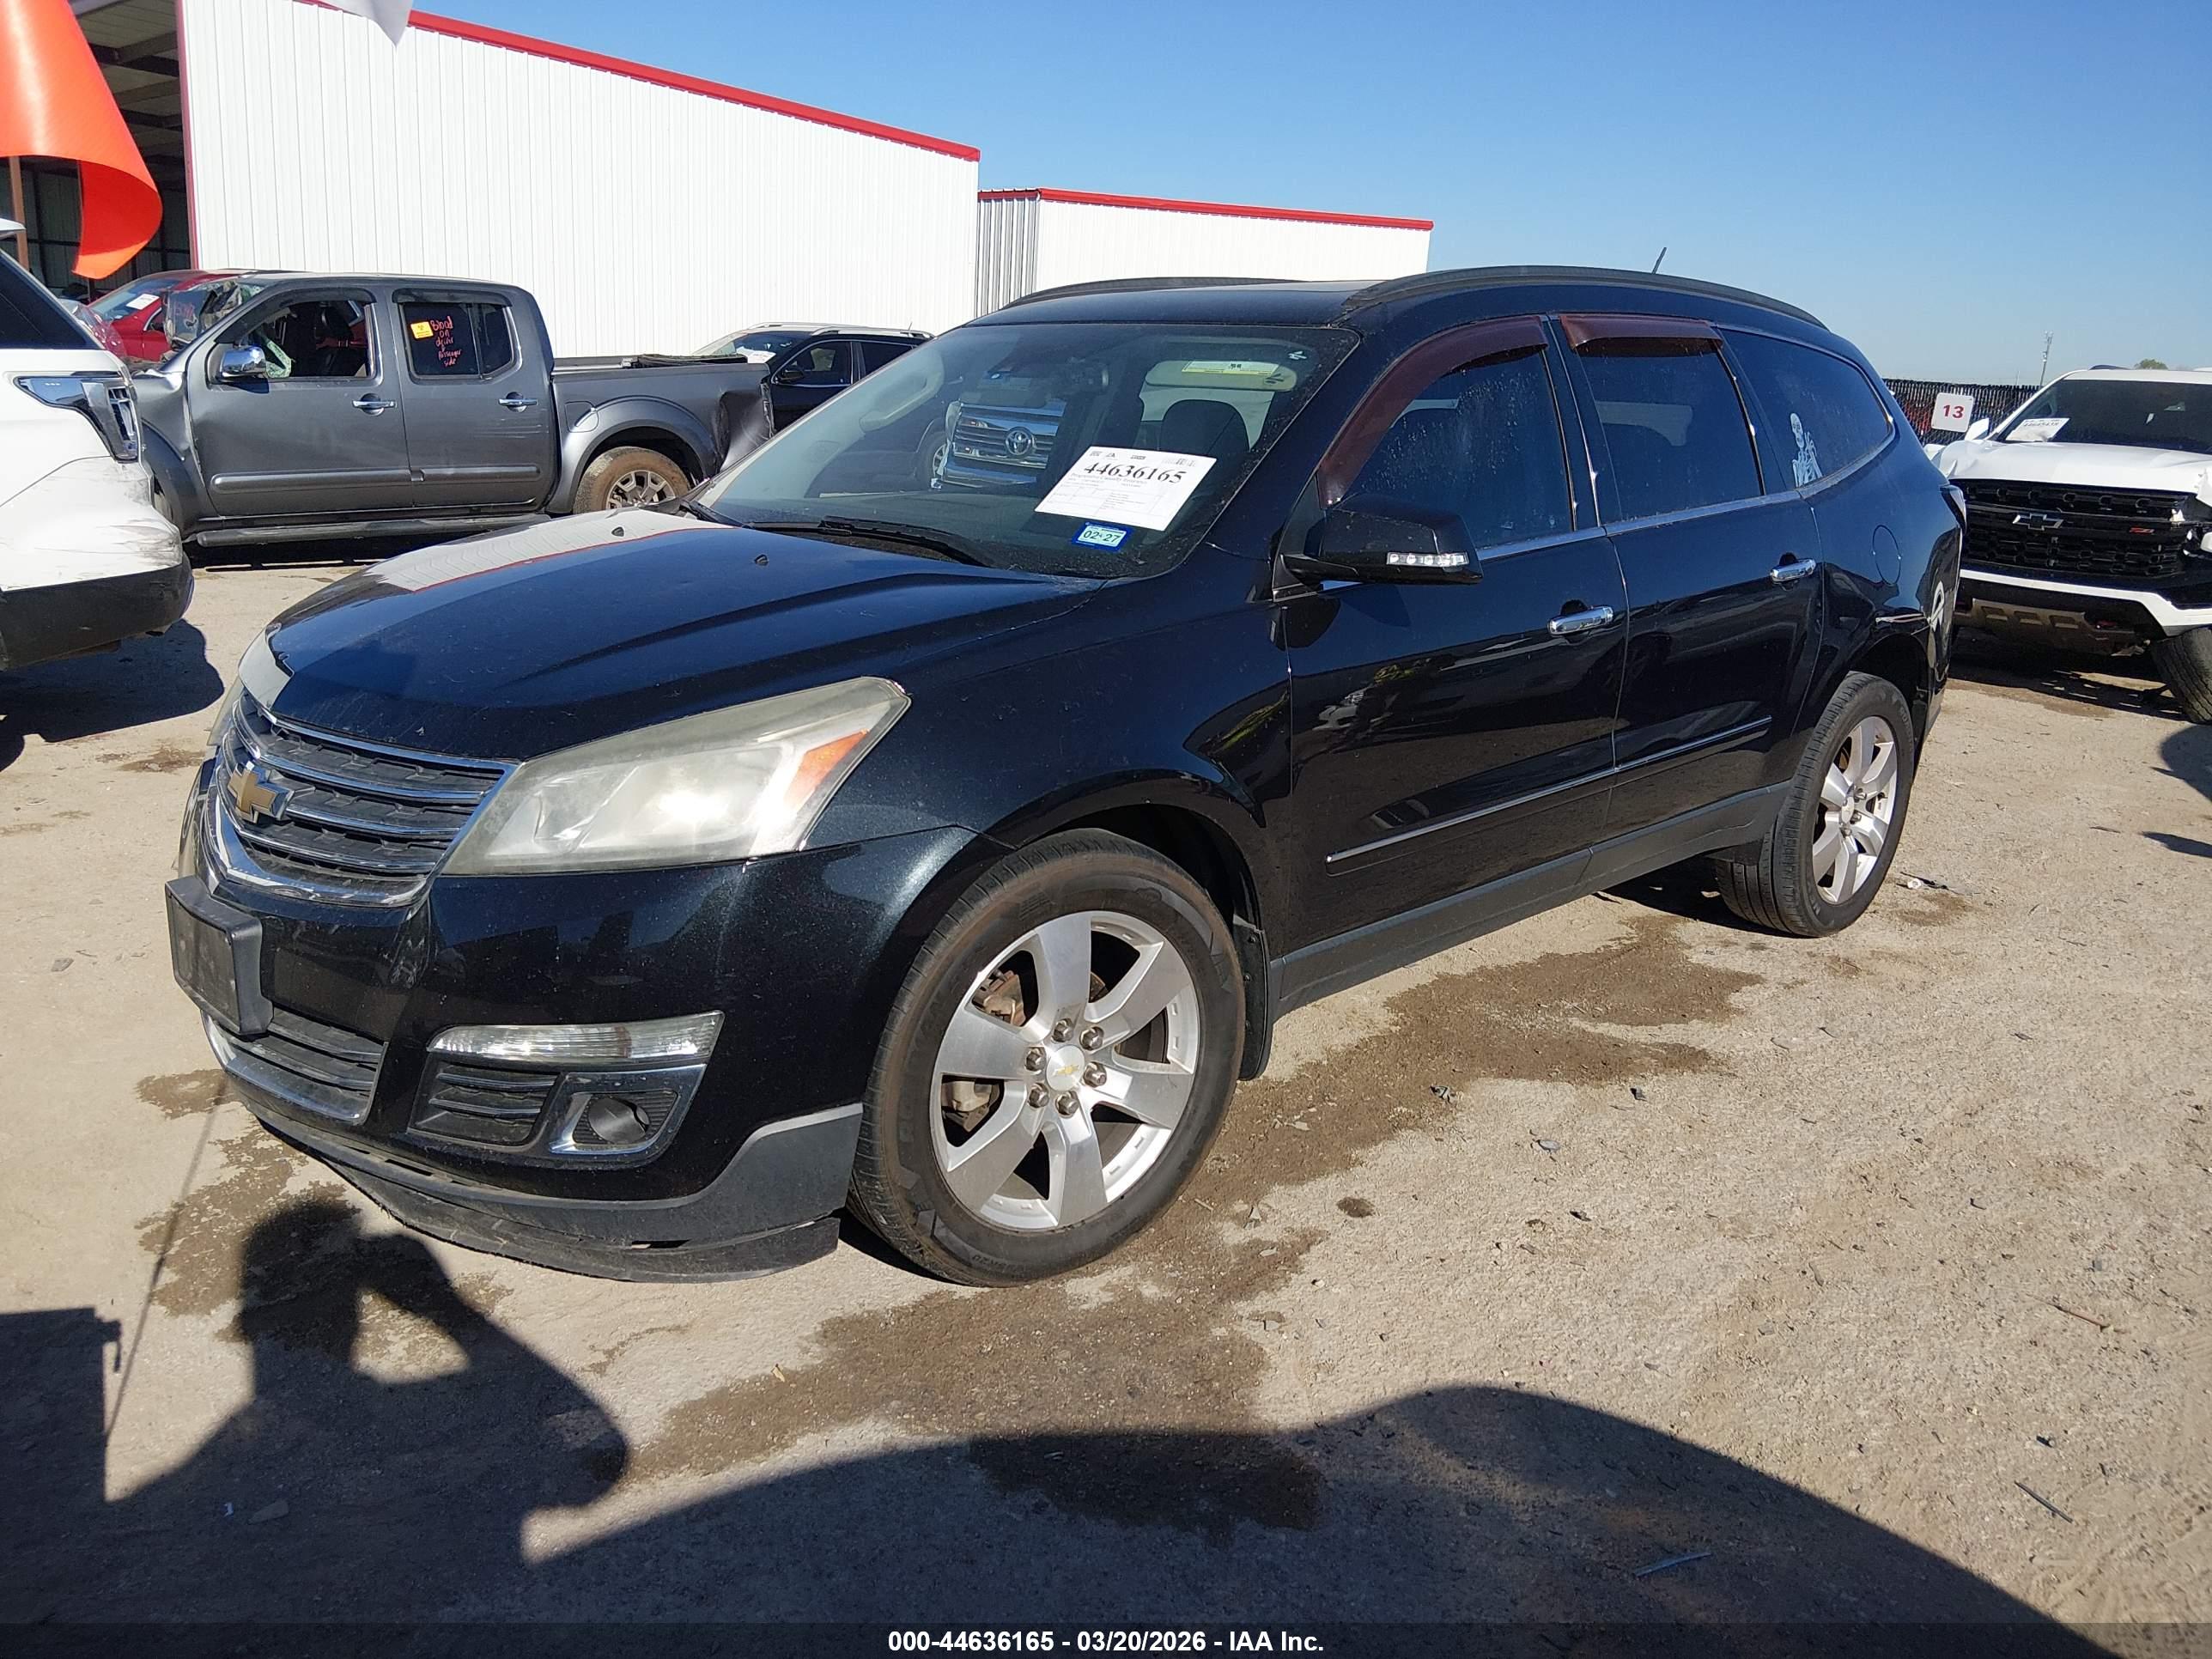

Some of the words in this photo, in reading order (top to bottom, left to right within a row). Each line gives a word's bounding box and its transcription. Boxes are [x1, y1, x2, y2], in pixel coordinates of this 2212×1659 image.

[430, 315, 453, 331] Blood
[1943, 404, 1965, 419] 13
[1084, 462, 1187, 483] 44636165
[1103, 533, 1121, 543] 27
